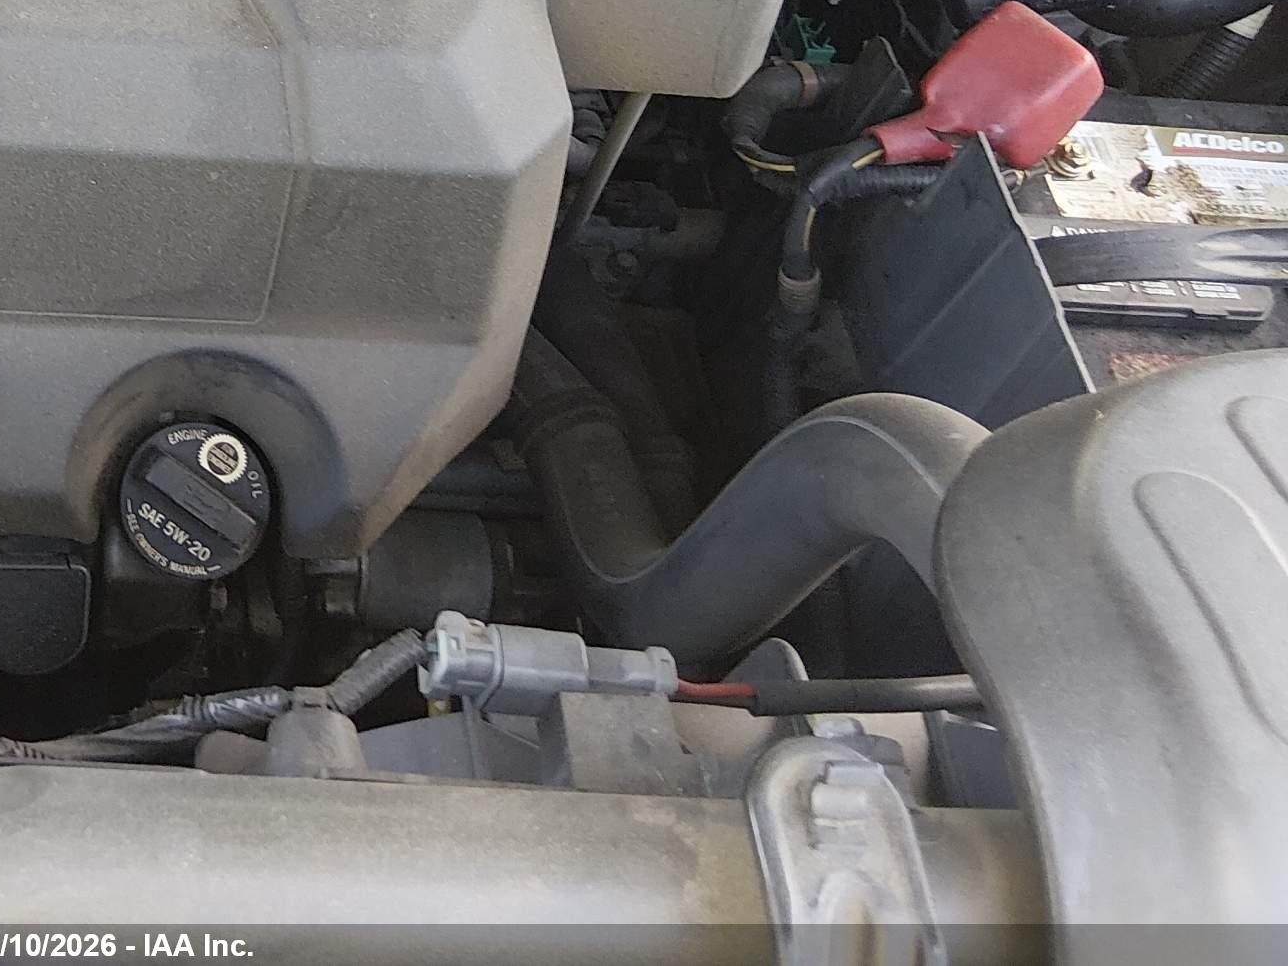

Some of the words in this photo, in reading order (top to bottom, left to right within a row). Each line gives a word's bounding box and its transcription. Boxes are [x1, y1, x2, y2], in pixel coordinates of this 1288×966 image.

[1172, 132, 1285, 154] ACDelco
[167, 428, 209, 445] ENGINE
[247, 470, 263, 499] OIL
[126, 513, 140, 533] SEE
[135, 532, 169, 567] OWNER'S
[168, 560, 208, 576] MANUAL
[138, 502, 166, 529] SAE
[162, 520, 212, 562] 5W-20
